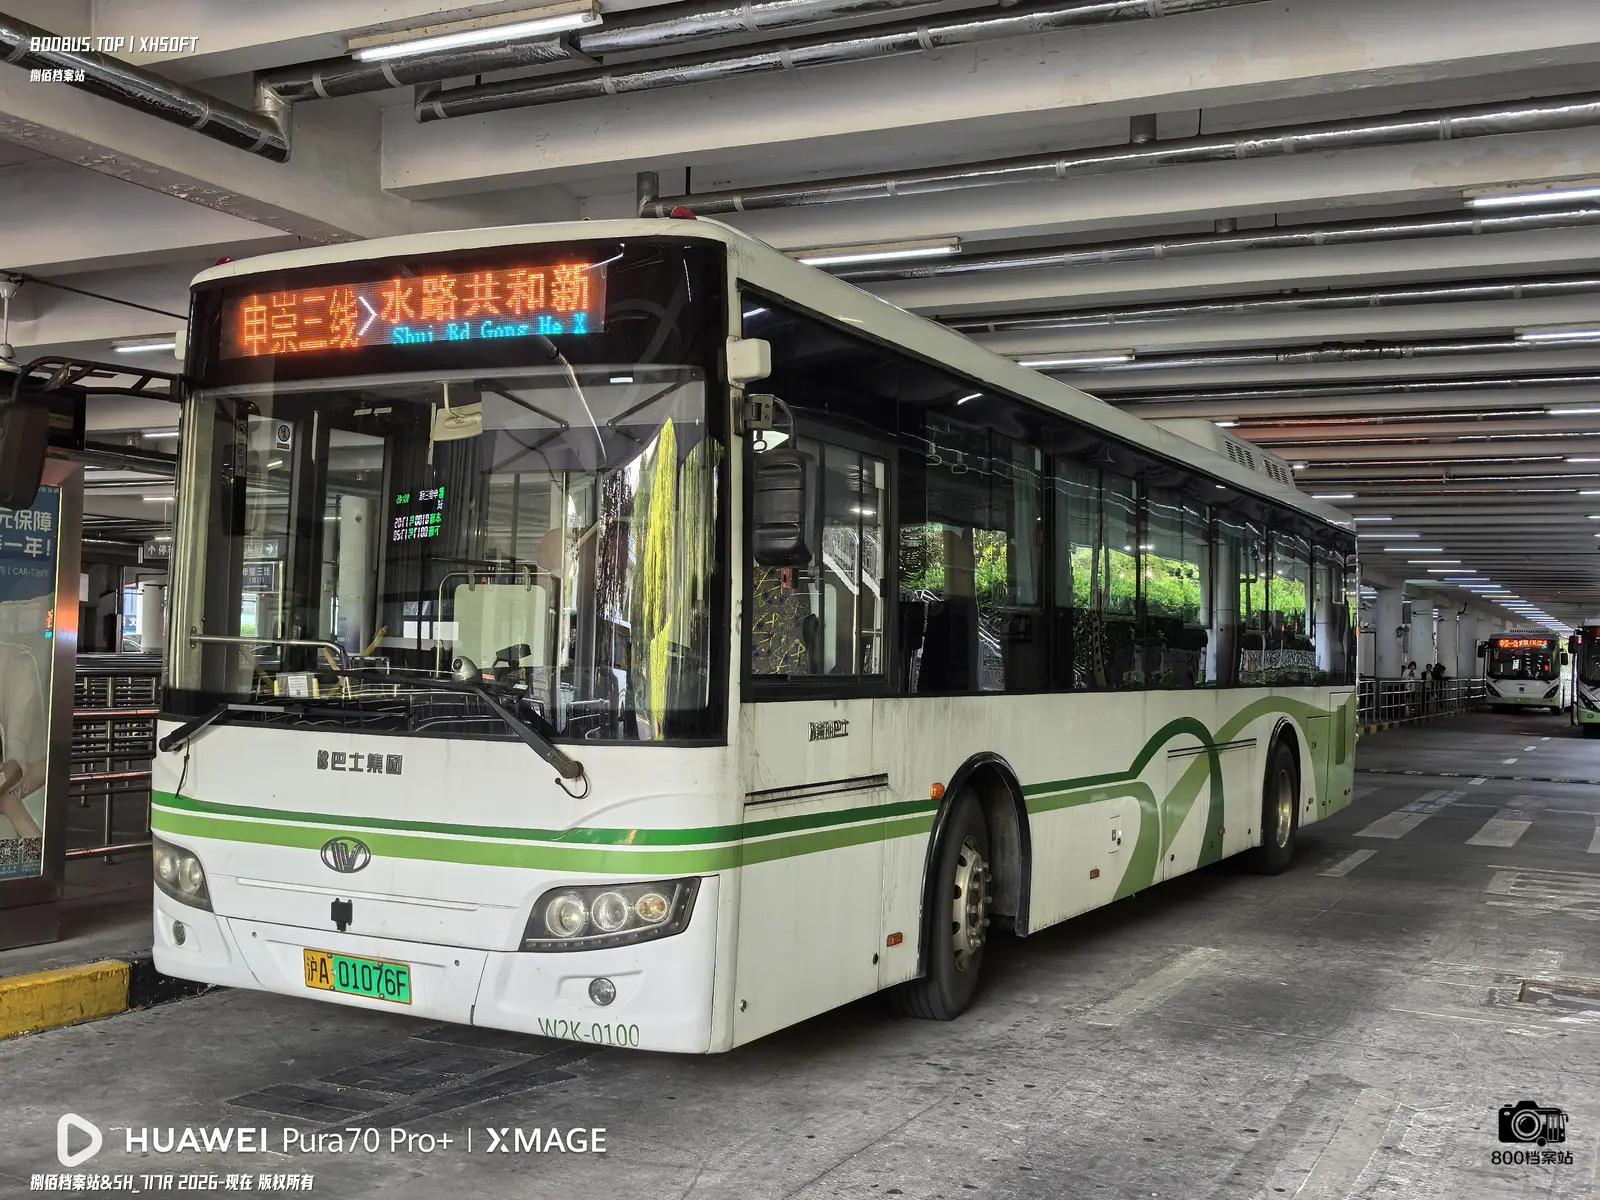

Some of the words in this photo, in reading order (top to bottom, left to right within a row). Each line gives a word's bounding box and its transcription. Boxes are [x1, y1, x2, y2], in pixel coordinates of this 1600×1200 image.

[380, 262, 590, 324] 水路共和新
[0, 534, 51, 558] 一年!
[537, 1017, 640, 1047] W2K-0100
